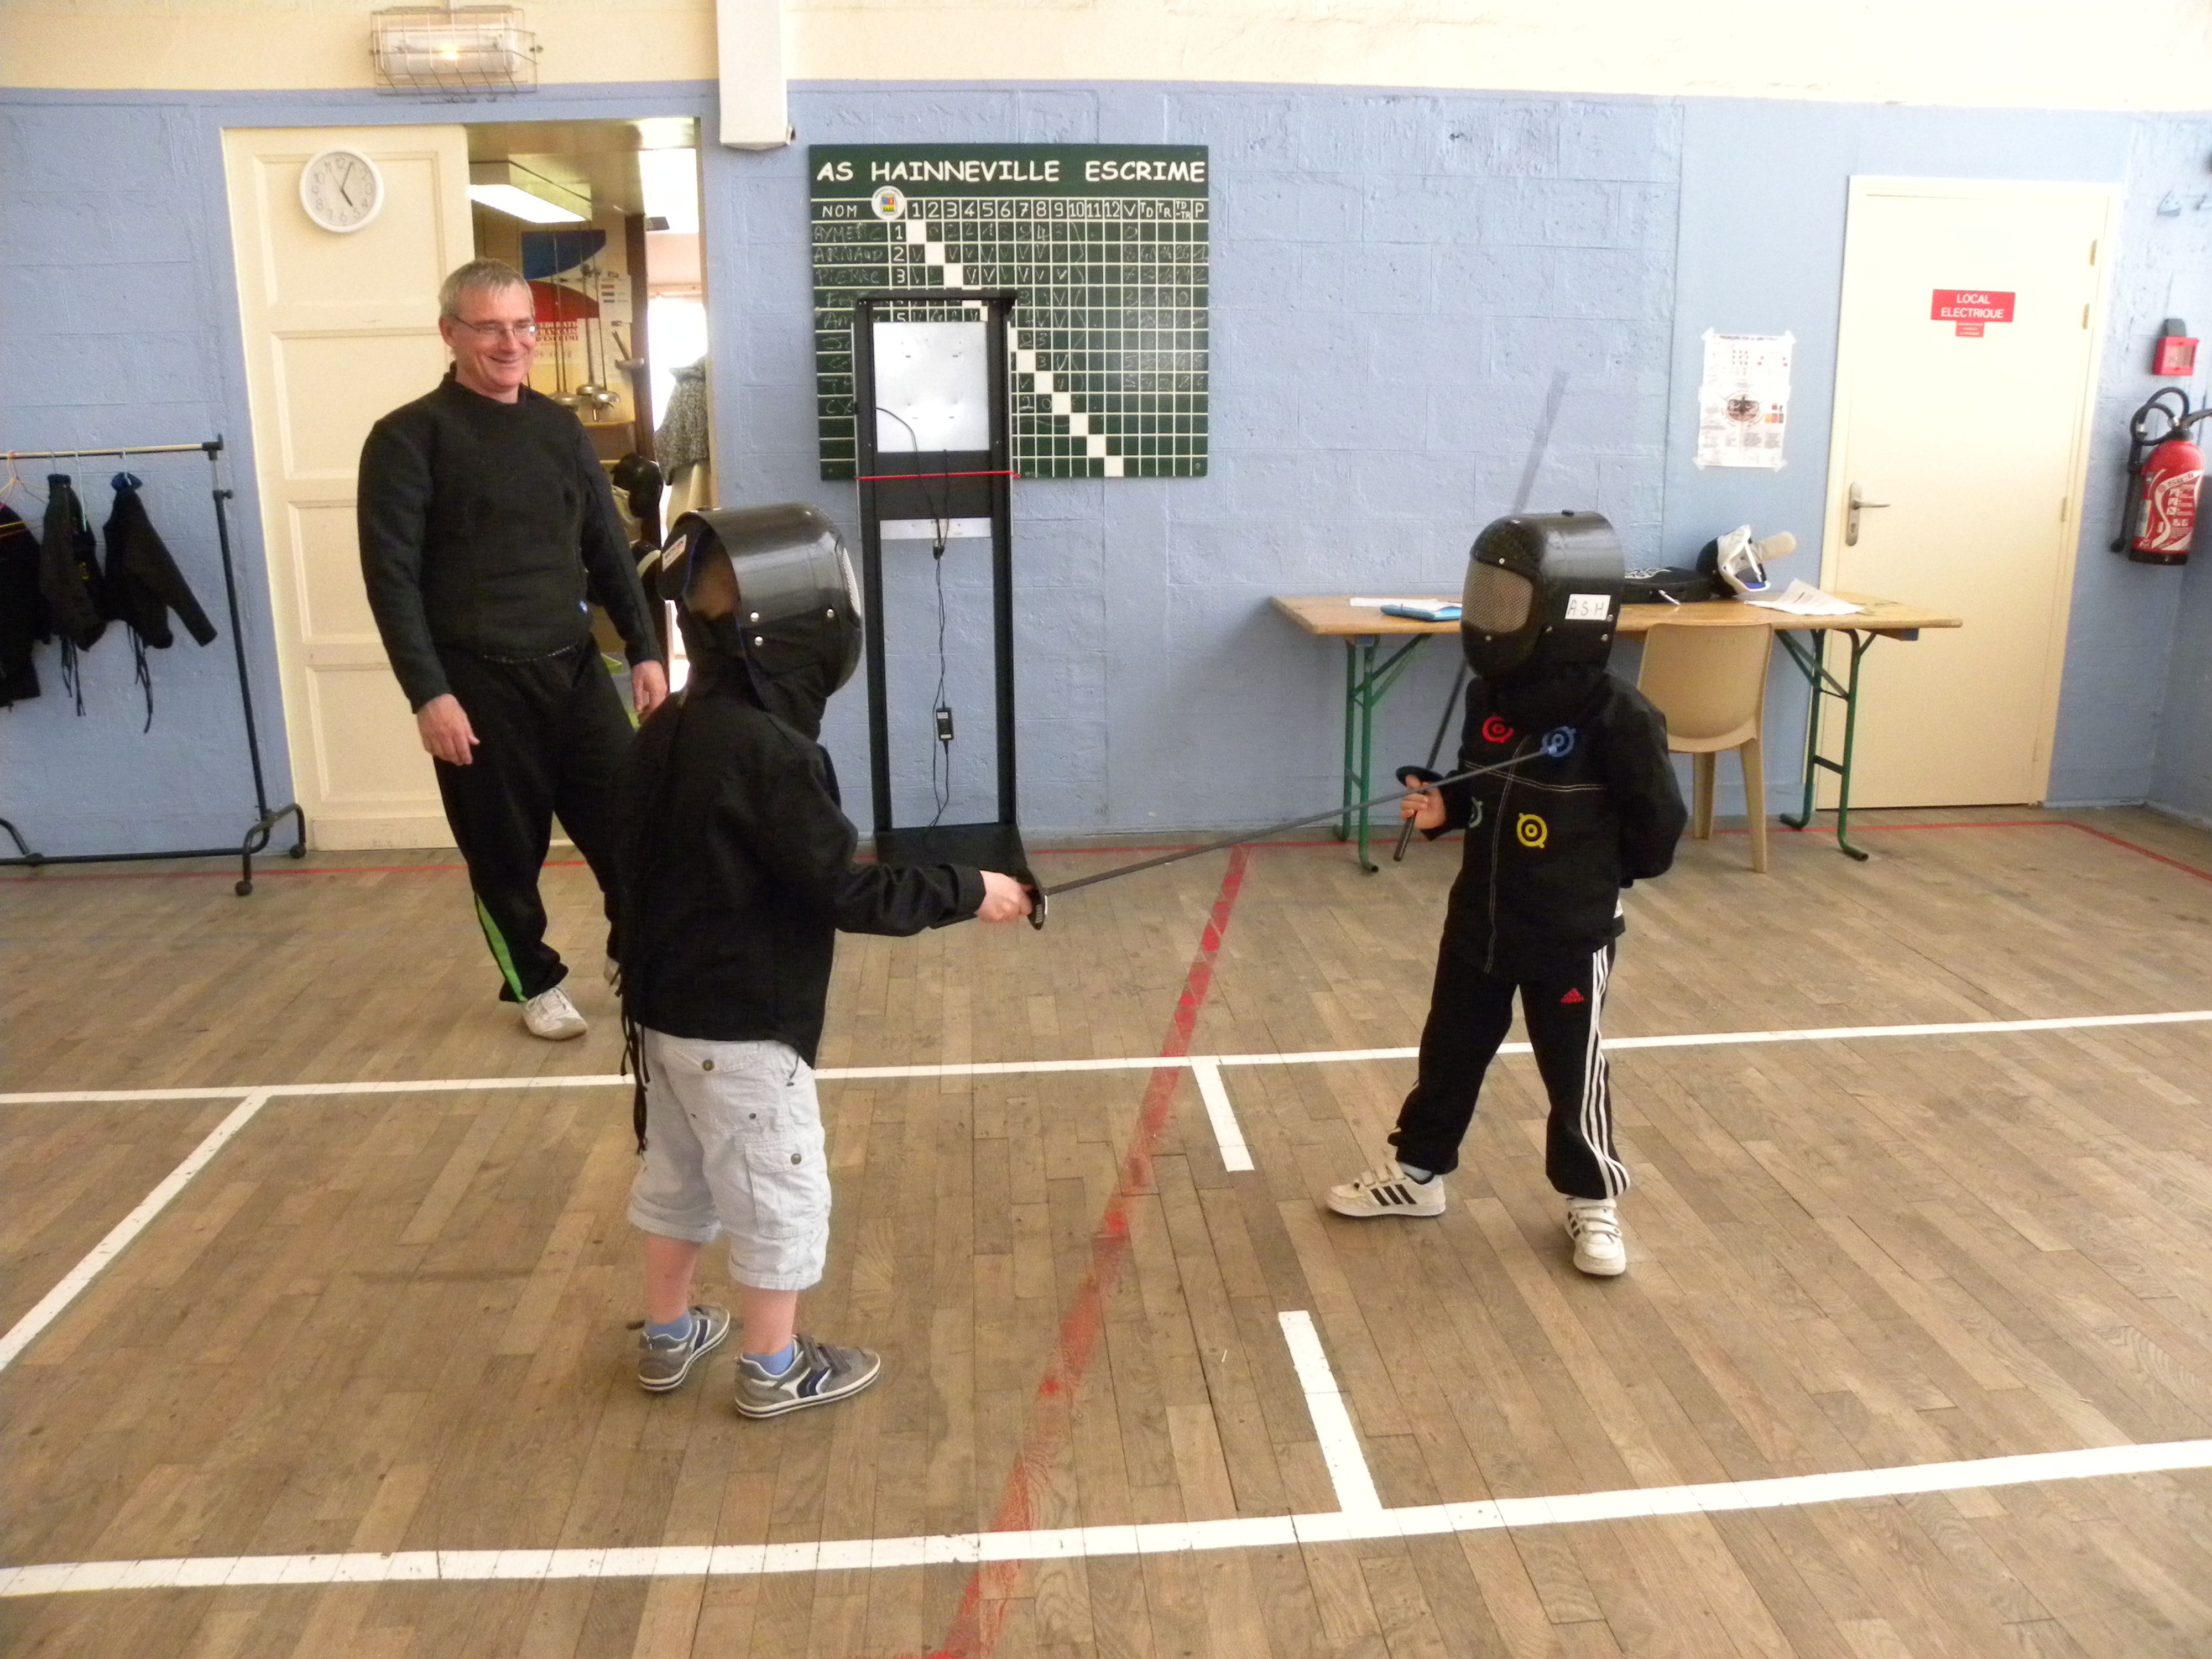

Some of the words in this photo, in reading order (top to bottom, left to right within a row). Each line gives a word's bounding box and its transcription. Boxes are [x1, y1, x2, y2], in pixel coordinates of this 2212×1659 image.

[817, 161, 854, 181] AS
[872, 160, 1060, 182] HAINNEVILLE
[1085, 161, 1206, 182] ESCRIME
[822, 205, 857, 218] NOM
[912, 202, 921, 217] 1
[928, 202, 940, 217] 2
[946, 202, 957, 217] 3
[964, 202, 975, 217] 4
[982, 202, 993, 217] 5
[1000, 201, 1011, 217] 6
[1019, 202, 1029, 217] 7
[1036, 201, 1047, 217] 8
[1054, 202, 1063, 217] 9
[1069, 202, 1084, 217] 10
[1087, 202, 1102, 217] 11
[1105, 201, 1120, 217] 12
[1124, 204, 1136, 216] V
[1140, 202, 1153, 218] TD
[1158, 202, 1171, 218] TR
[1176, 201, 1187, 210] TD
[1195, 202, 1204, 218] P
[895, 225, 902, 239] 1
[893, 247, 905, 262] 2
[897, 269, 905, 283] 3
[1957, 294, 1990, 304] LOCAL
[1941, 307, 2004, 319] ELECTRIQUE
